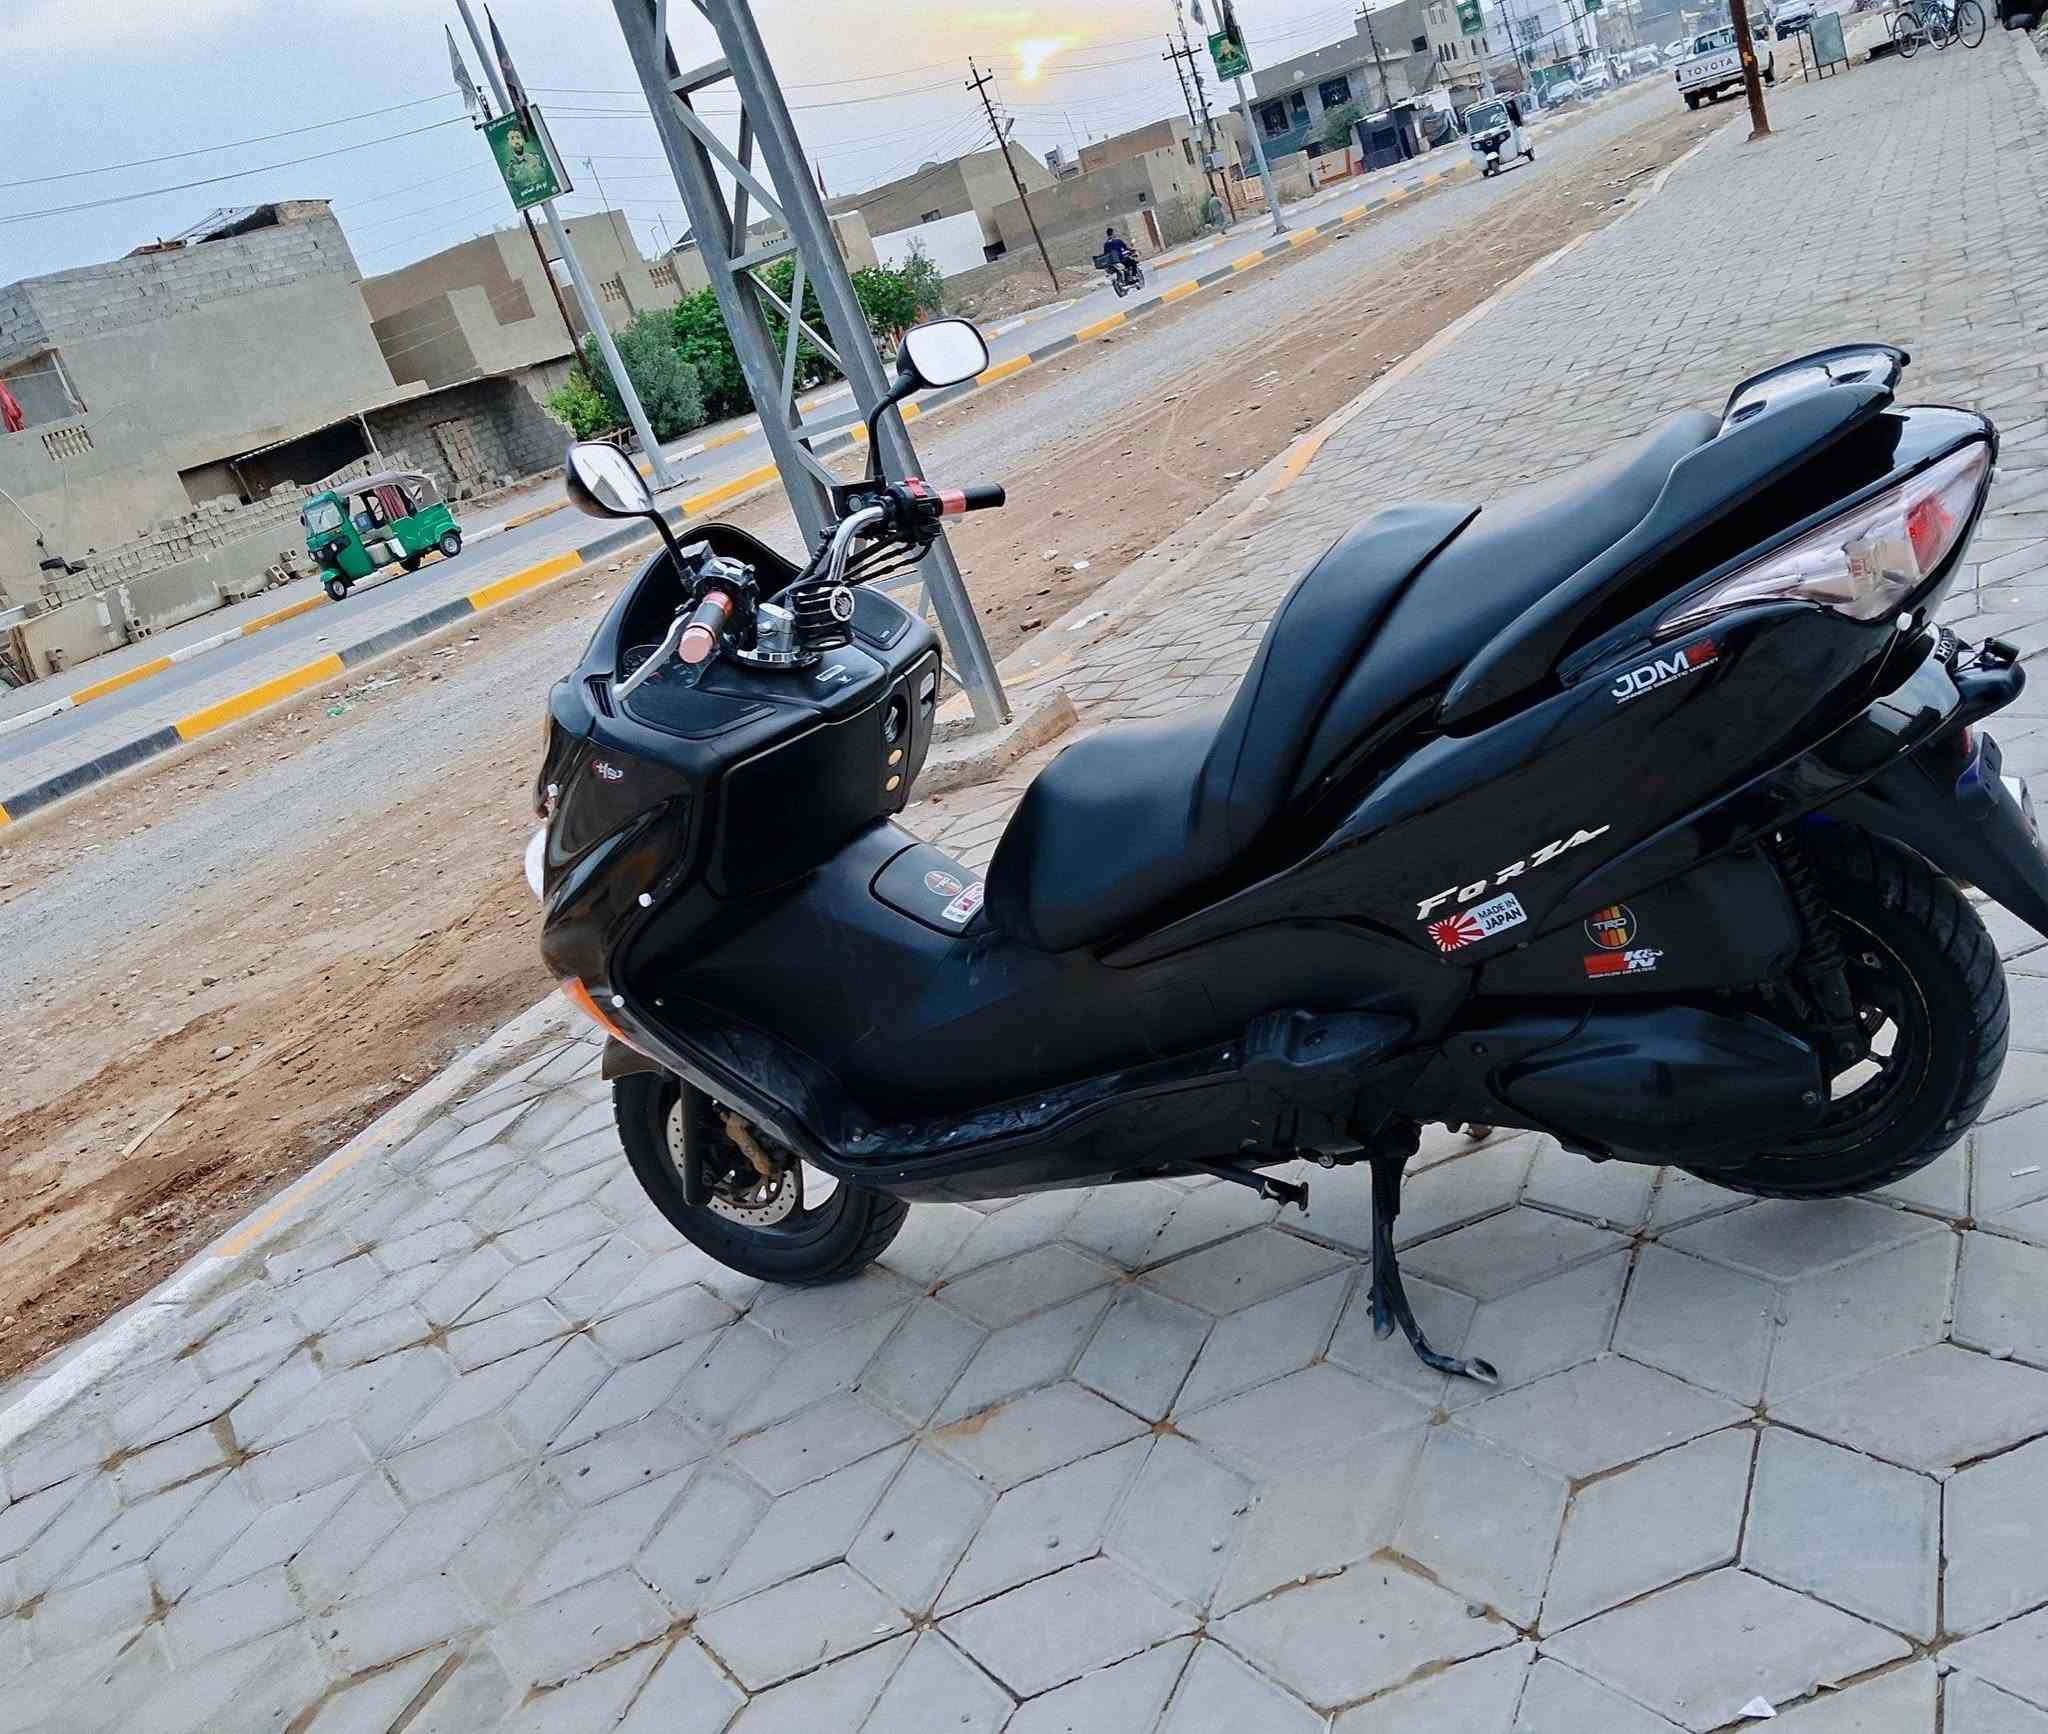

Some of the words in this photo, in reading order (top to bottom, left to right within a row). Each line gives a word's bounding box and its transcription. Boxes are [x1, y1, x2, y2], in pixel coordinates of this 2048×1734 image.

[1687, 57, 1733, 77] TOYOTA
[1611, 651, 1690, 697] JDM
[1477, 902, 1506, 920] MADE
[1505, 897, 1519, 911] IN
[1484, 907, 1523, 931] JAPAN
